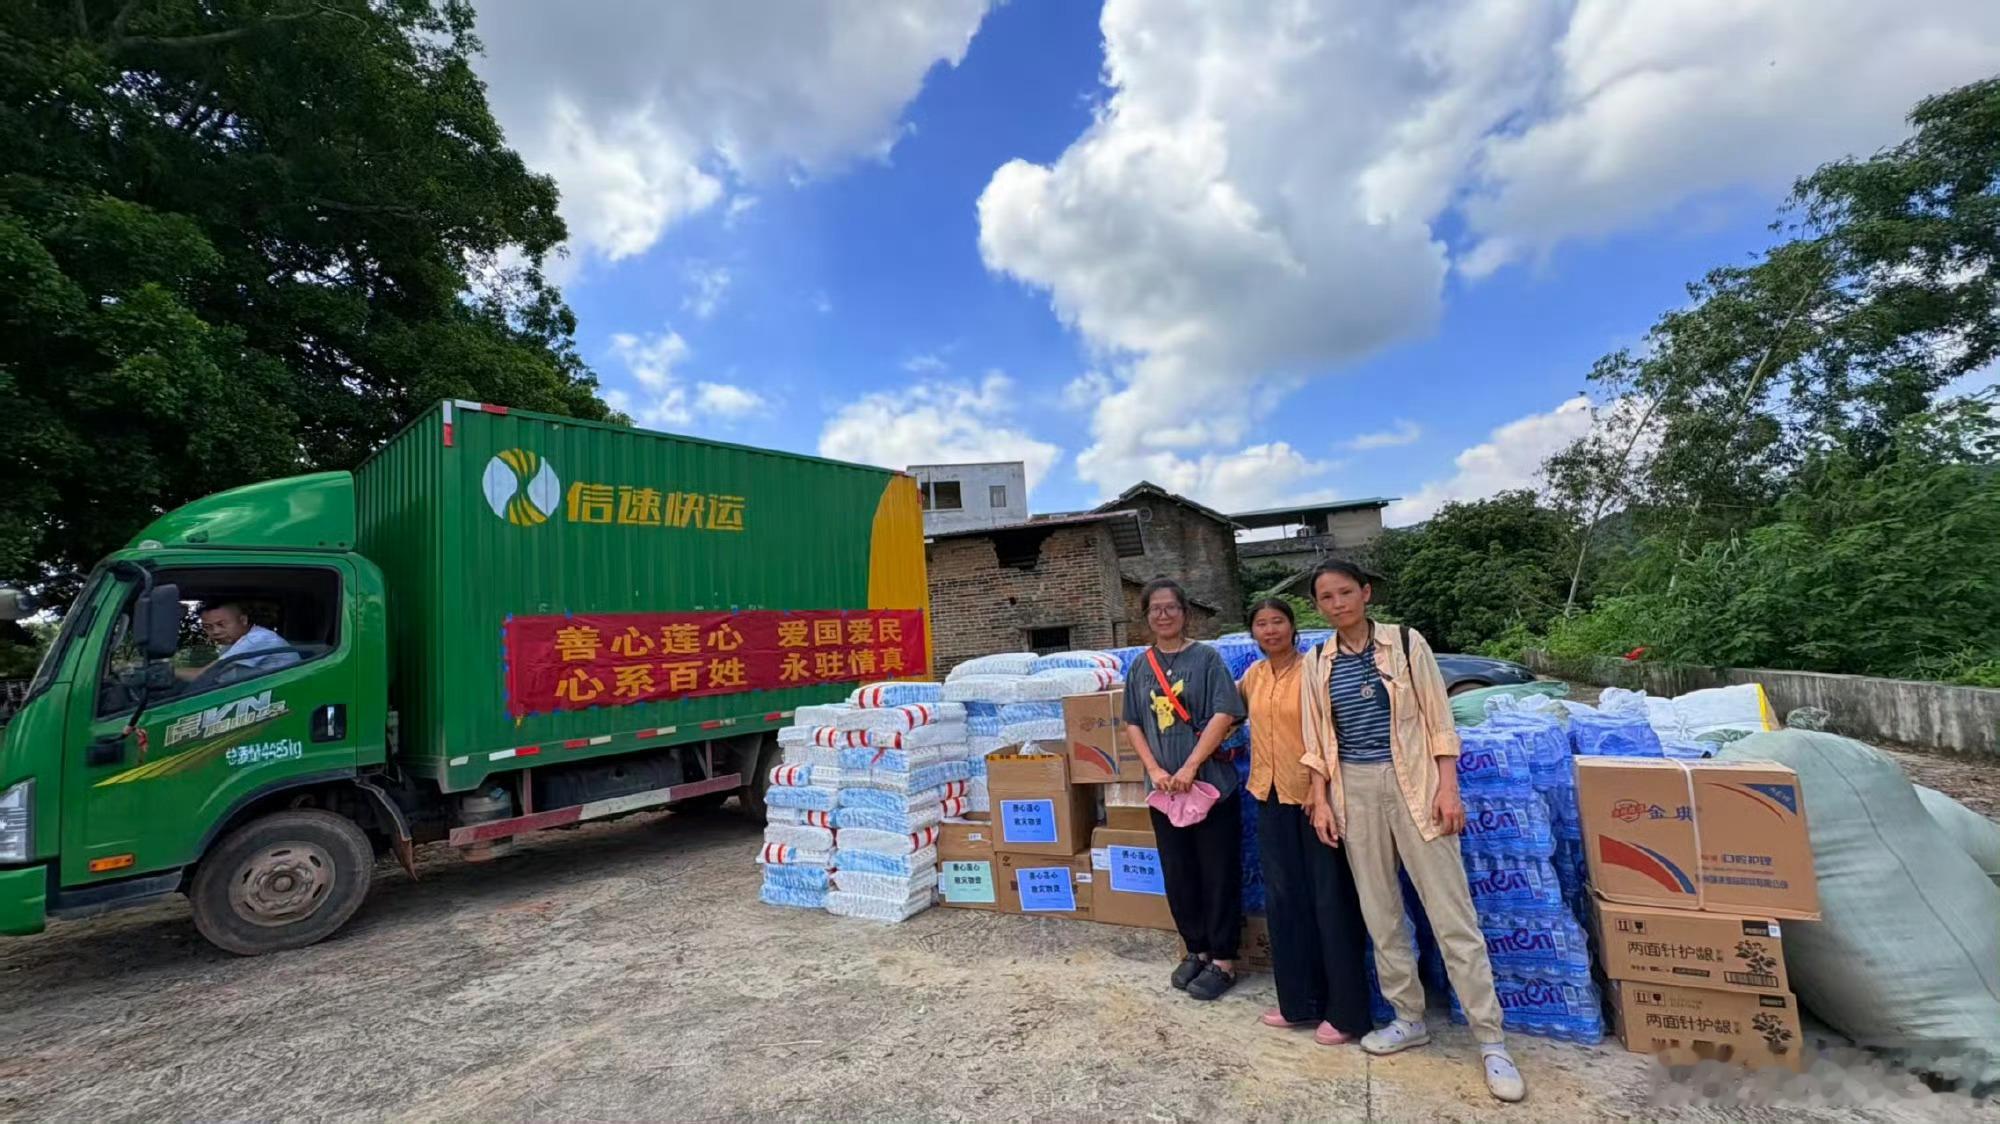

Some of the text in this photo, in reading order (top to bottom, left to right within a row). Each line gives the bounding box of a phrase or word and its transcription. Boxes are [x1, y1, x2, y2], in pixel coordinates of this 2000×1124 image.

[567, 481, 745, 531] 信速快运
[554, 617, 902, 662] 善心莲心 爱国爱民
[554, 647, 905, 702] 心系百姓 永驻情真
